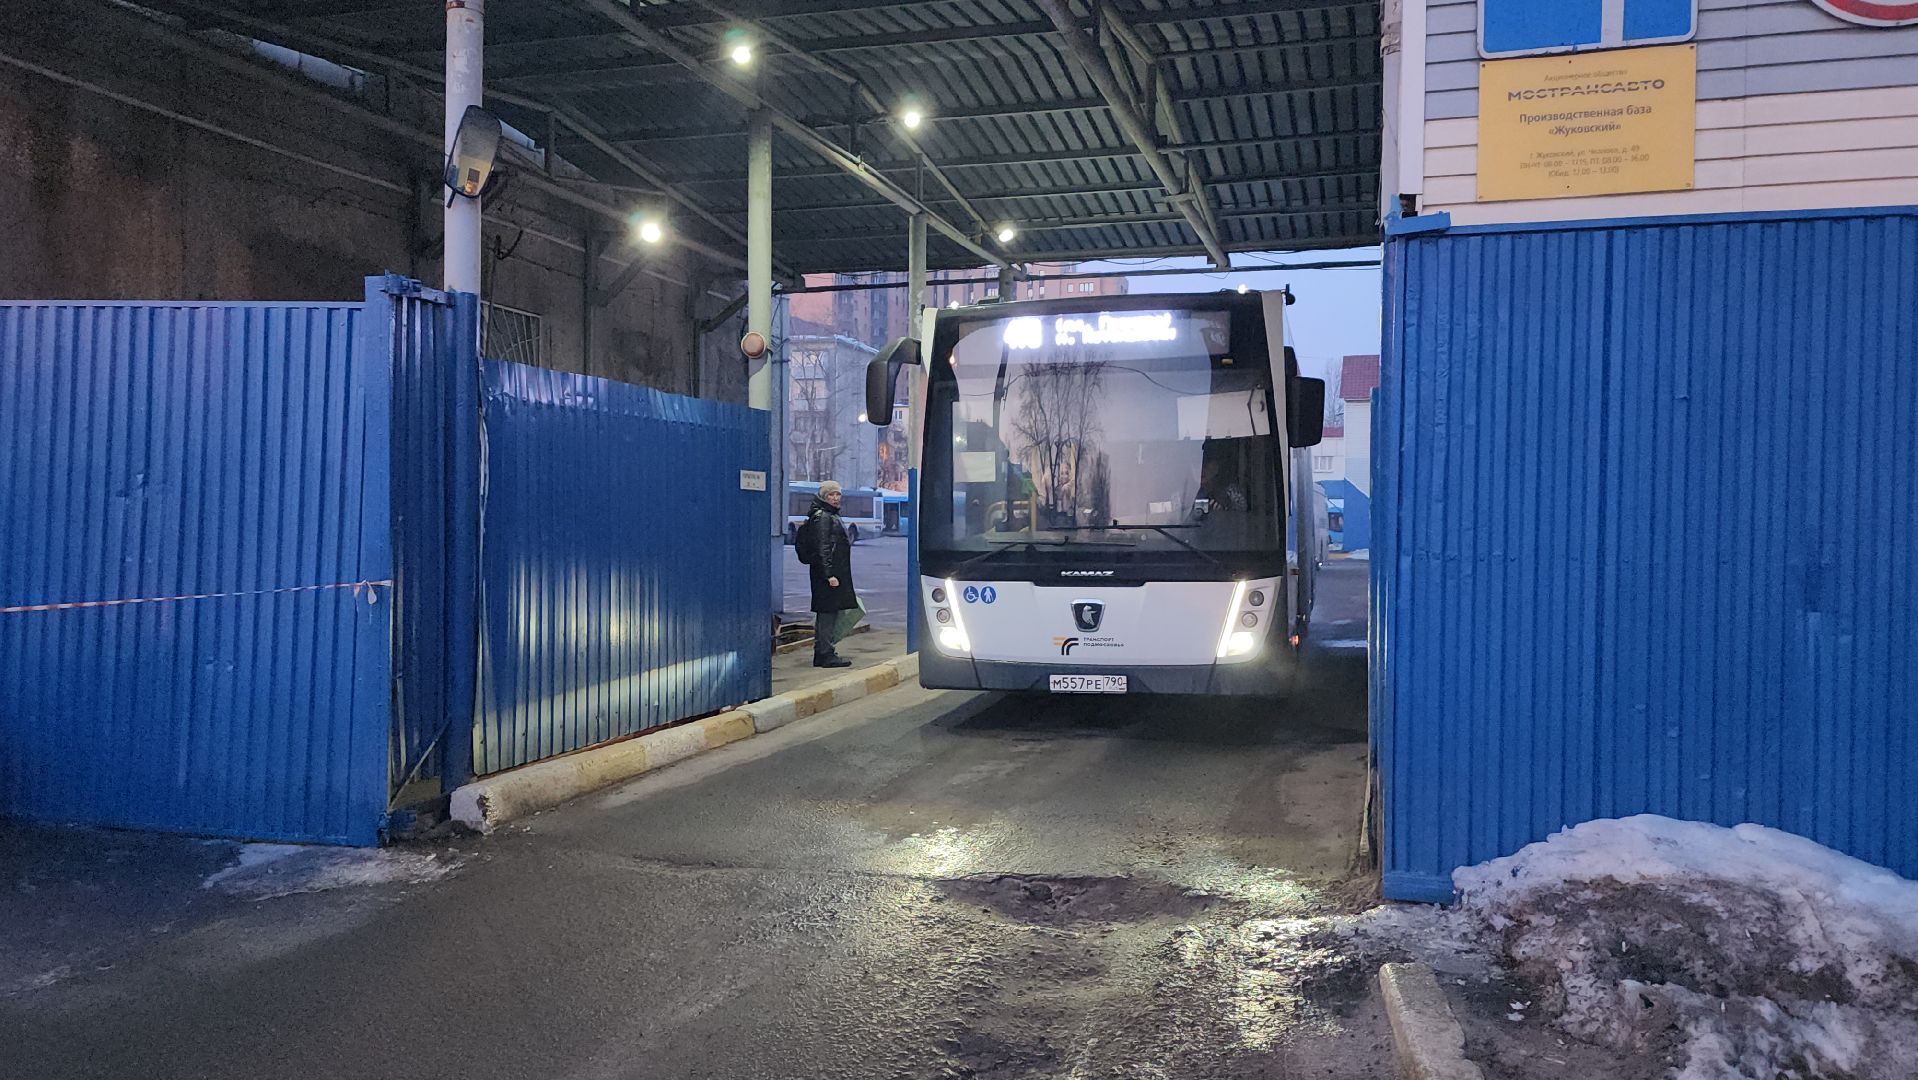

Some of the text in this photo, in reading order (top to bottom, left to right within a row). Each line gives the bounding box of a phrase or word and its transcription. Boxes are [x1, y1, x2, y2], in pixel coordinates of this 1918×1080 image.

[1508, 79, 1665, 101] МОСТРАНСАВТО
[1519, 104, 1652, 124] Производственная база
[1549, 121, 1621, 137] «Жуковский»
